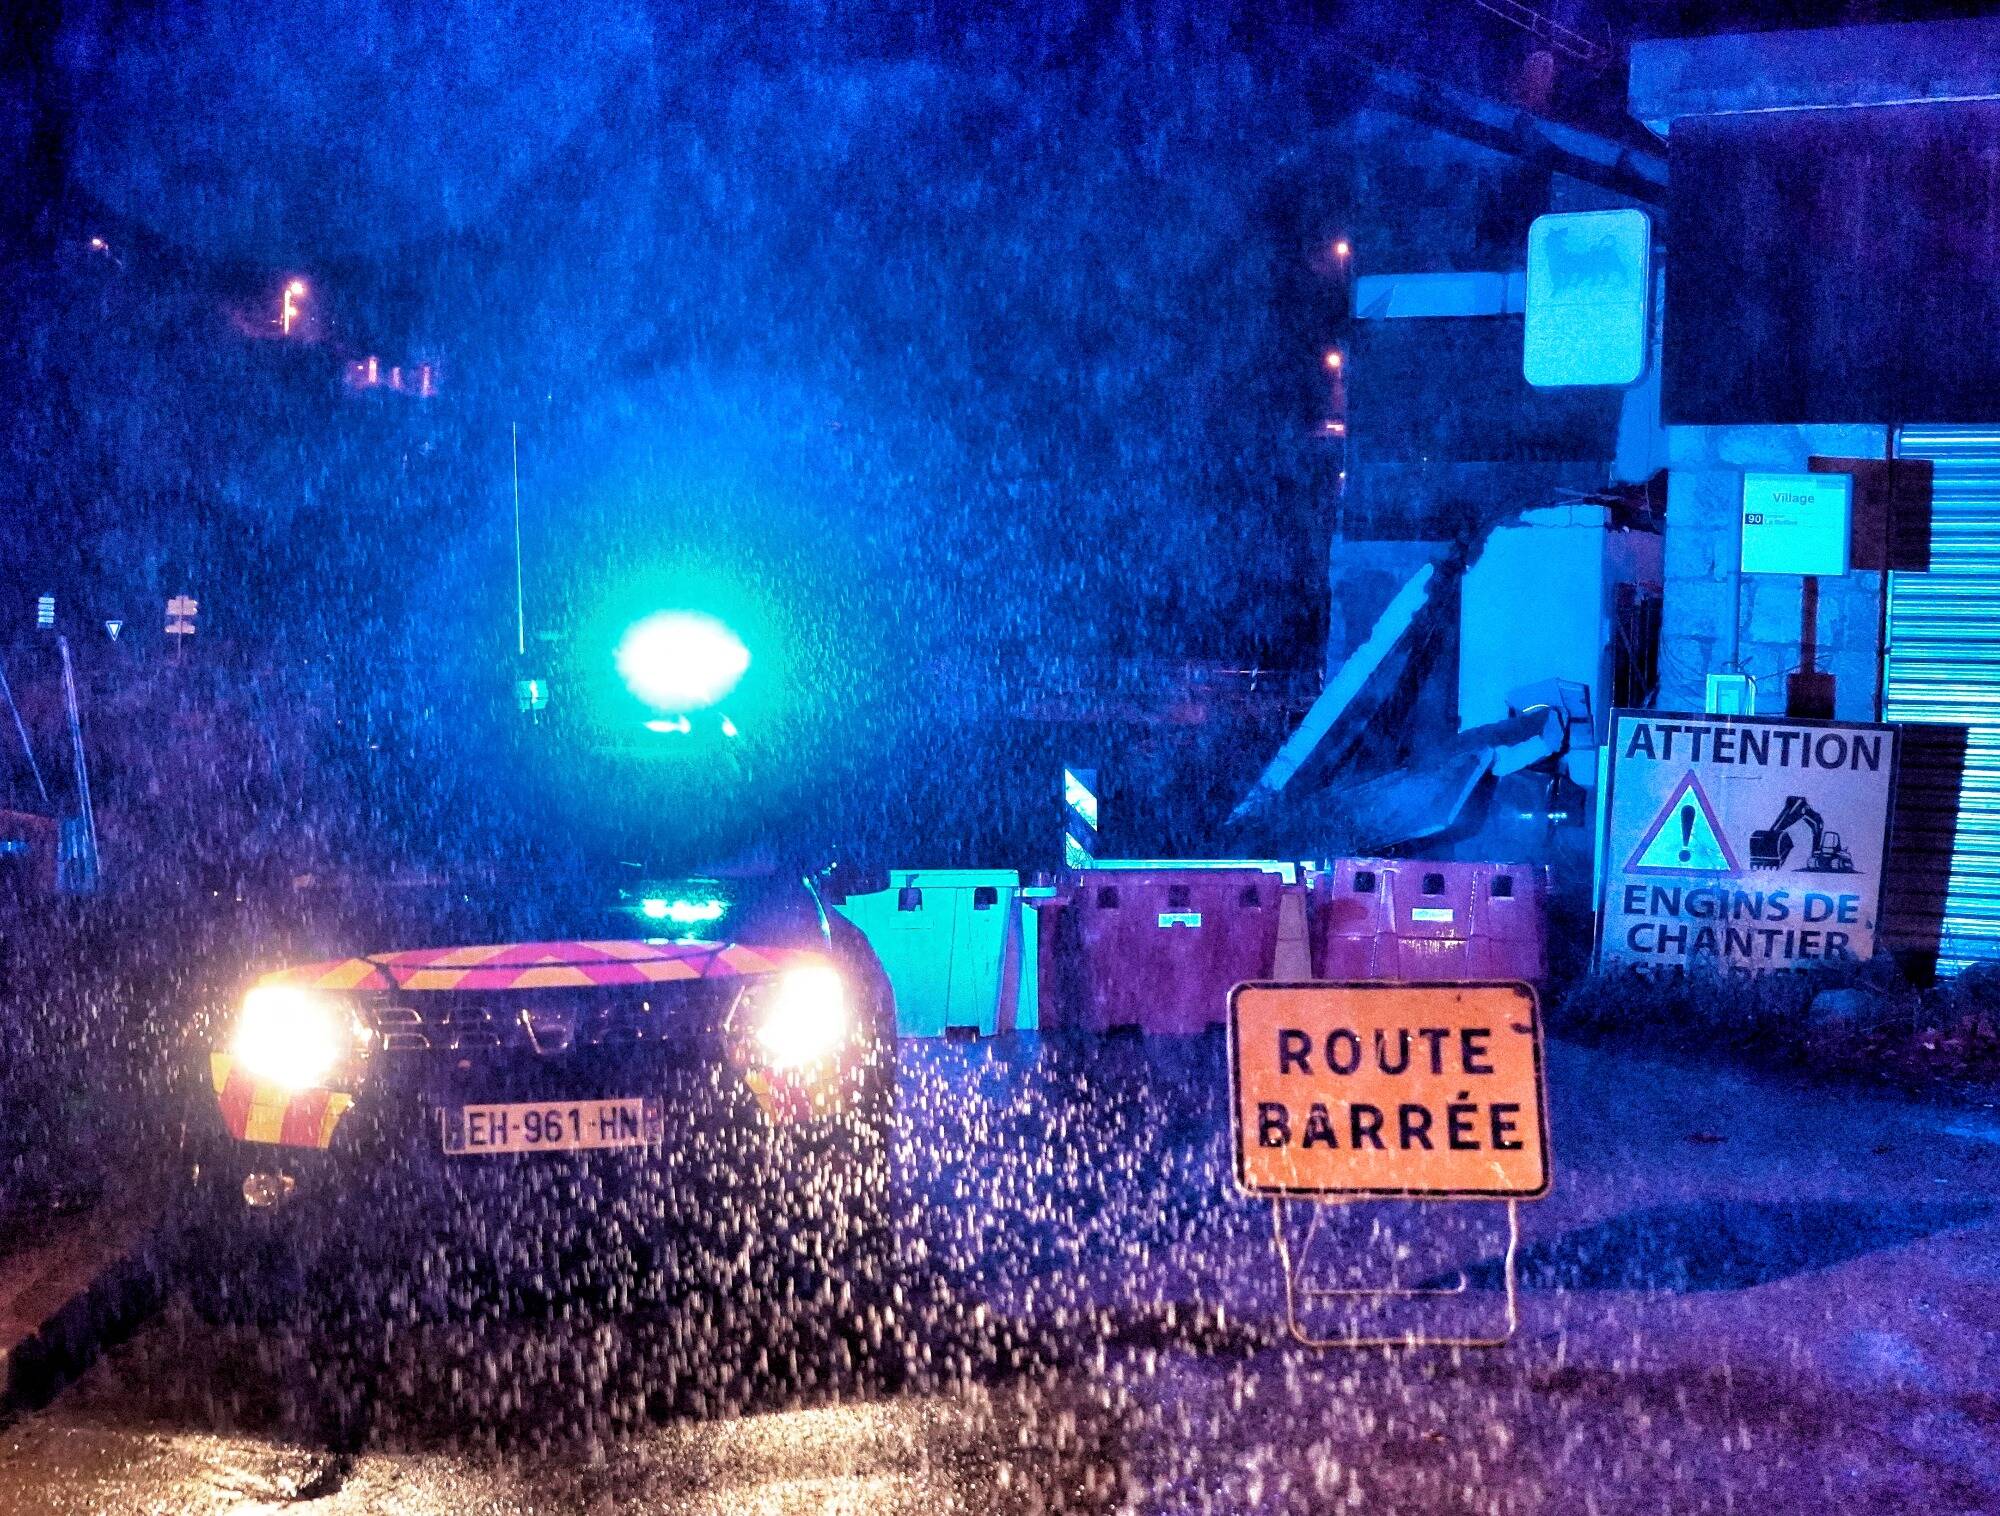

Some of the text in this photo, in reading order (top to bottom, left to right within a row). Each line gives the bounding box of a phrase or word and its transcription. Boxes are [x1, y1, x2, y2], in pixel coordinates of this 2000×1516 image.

[1773, 493, 1814, 505] Village
[1748, 515, 1761, 523] 90
[1626, 723, 1881, 771] ATTENTION
[1624, 885, 1860, 923] ENGINS DE
[1626, 922, 1850, 960] CHANTIER
[1278, 1028, 1494, 1075] ROUTE
[469, 1106, 638, 1145] EH-961-HN
[1258, 1091, 1523, 1150] BARRÉE
